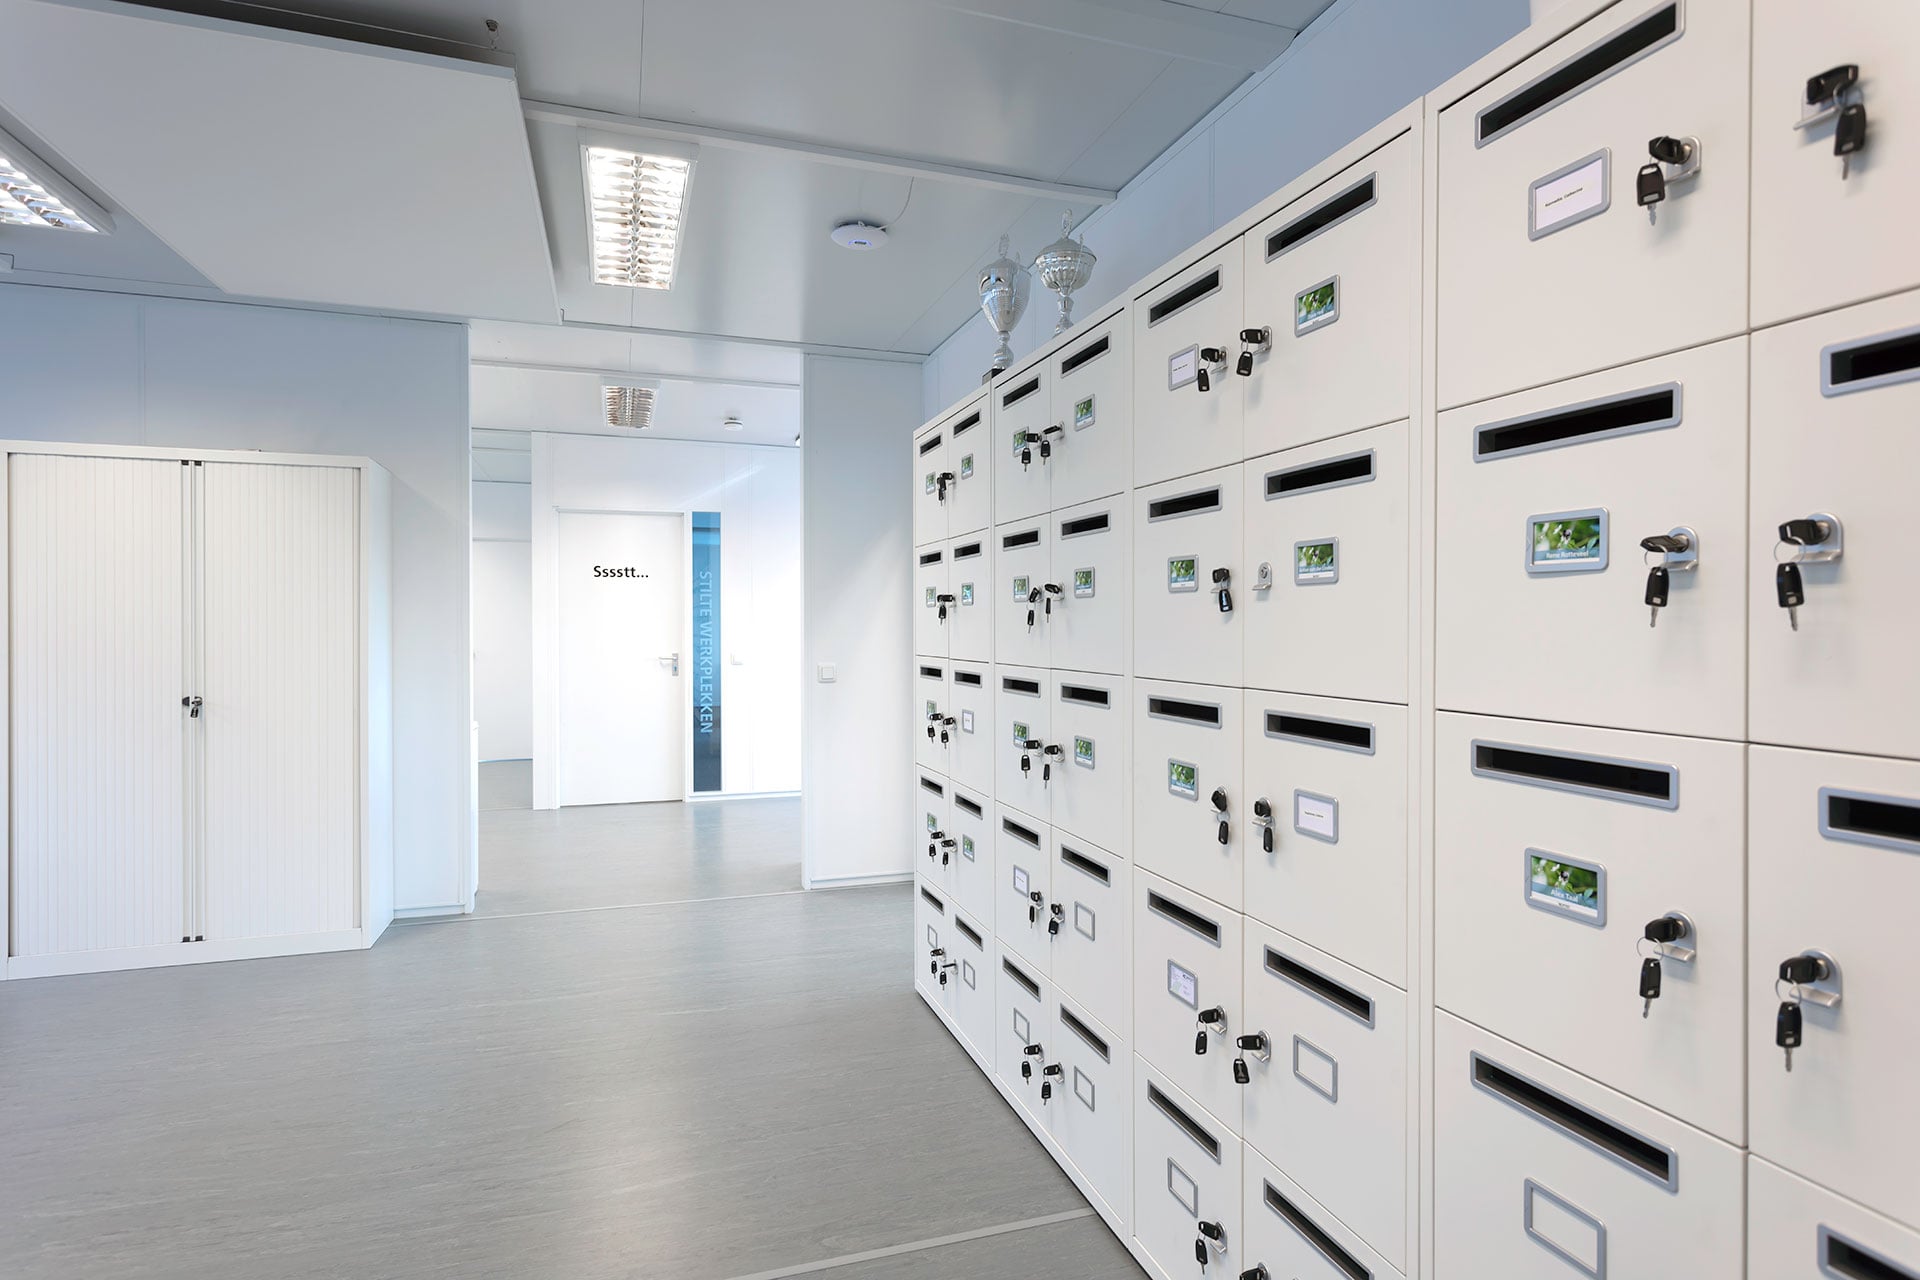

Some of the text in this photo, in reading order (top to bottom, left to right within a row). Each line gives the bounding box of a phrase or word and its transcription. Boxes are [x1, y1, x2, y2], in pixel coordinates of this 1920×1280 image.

[593, 565, 649, 578] Sssstt...
[700, 571, 713, 733] STILTE WERKPLEKKEN
